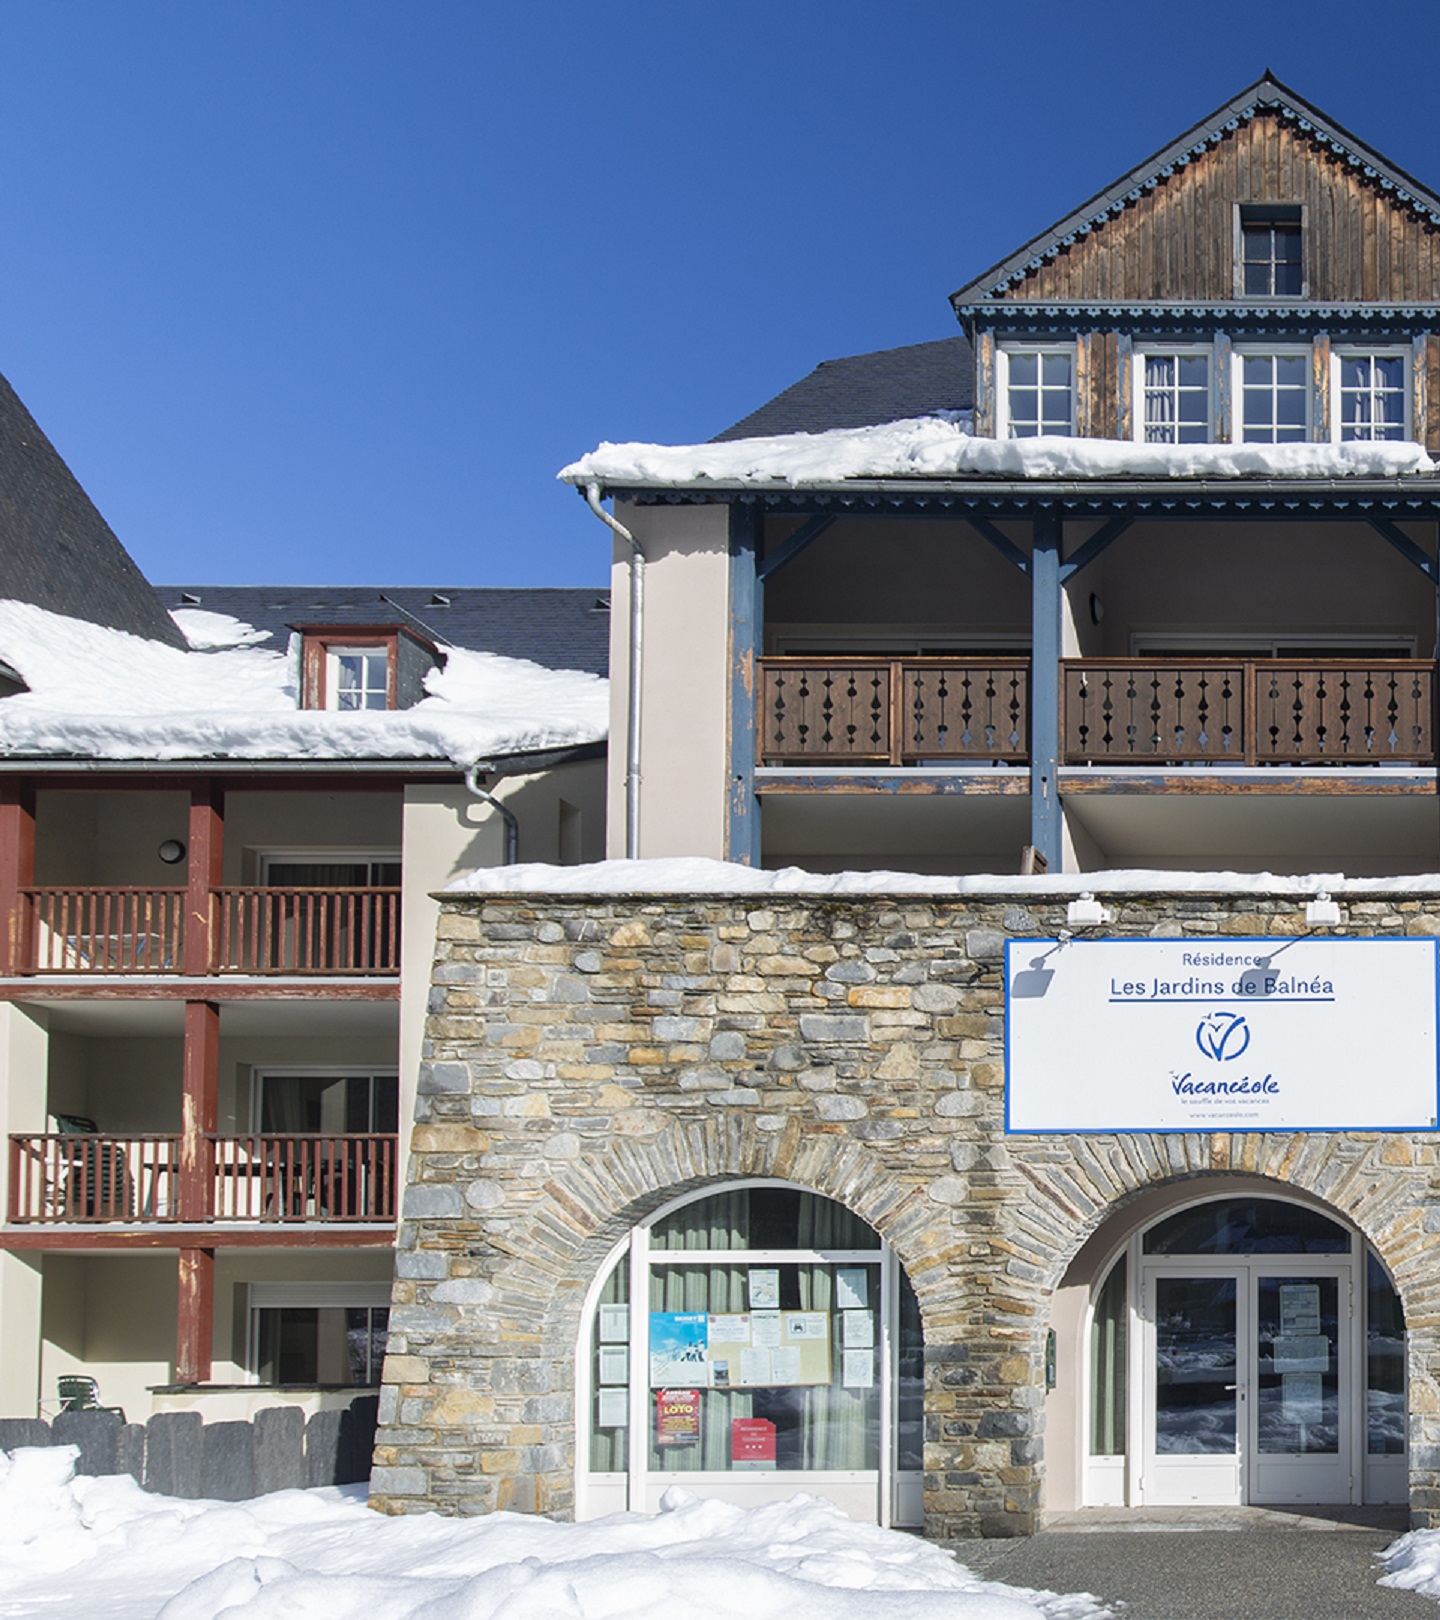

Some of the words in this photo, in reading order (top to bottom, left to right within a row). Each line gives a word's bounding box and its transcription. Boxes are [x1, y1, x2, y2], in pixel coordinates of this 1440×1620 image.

[1182, 952, 1263, 967] Résidence
[1111, 978, 1146, 995] Les
[1151, 977, 1225, 998] Jardins
[1231, 977, 1257, 995] de
[1264, 975, 1335, 995] Balnéa
[1171, 1072, 1280, 1096] Vacancéole
[1214, 1097, 1222, 1105] de
